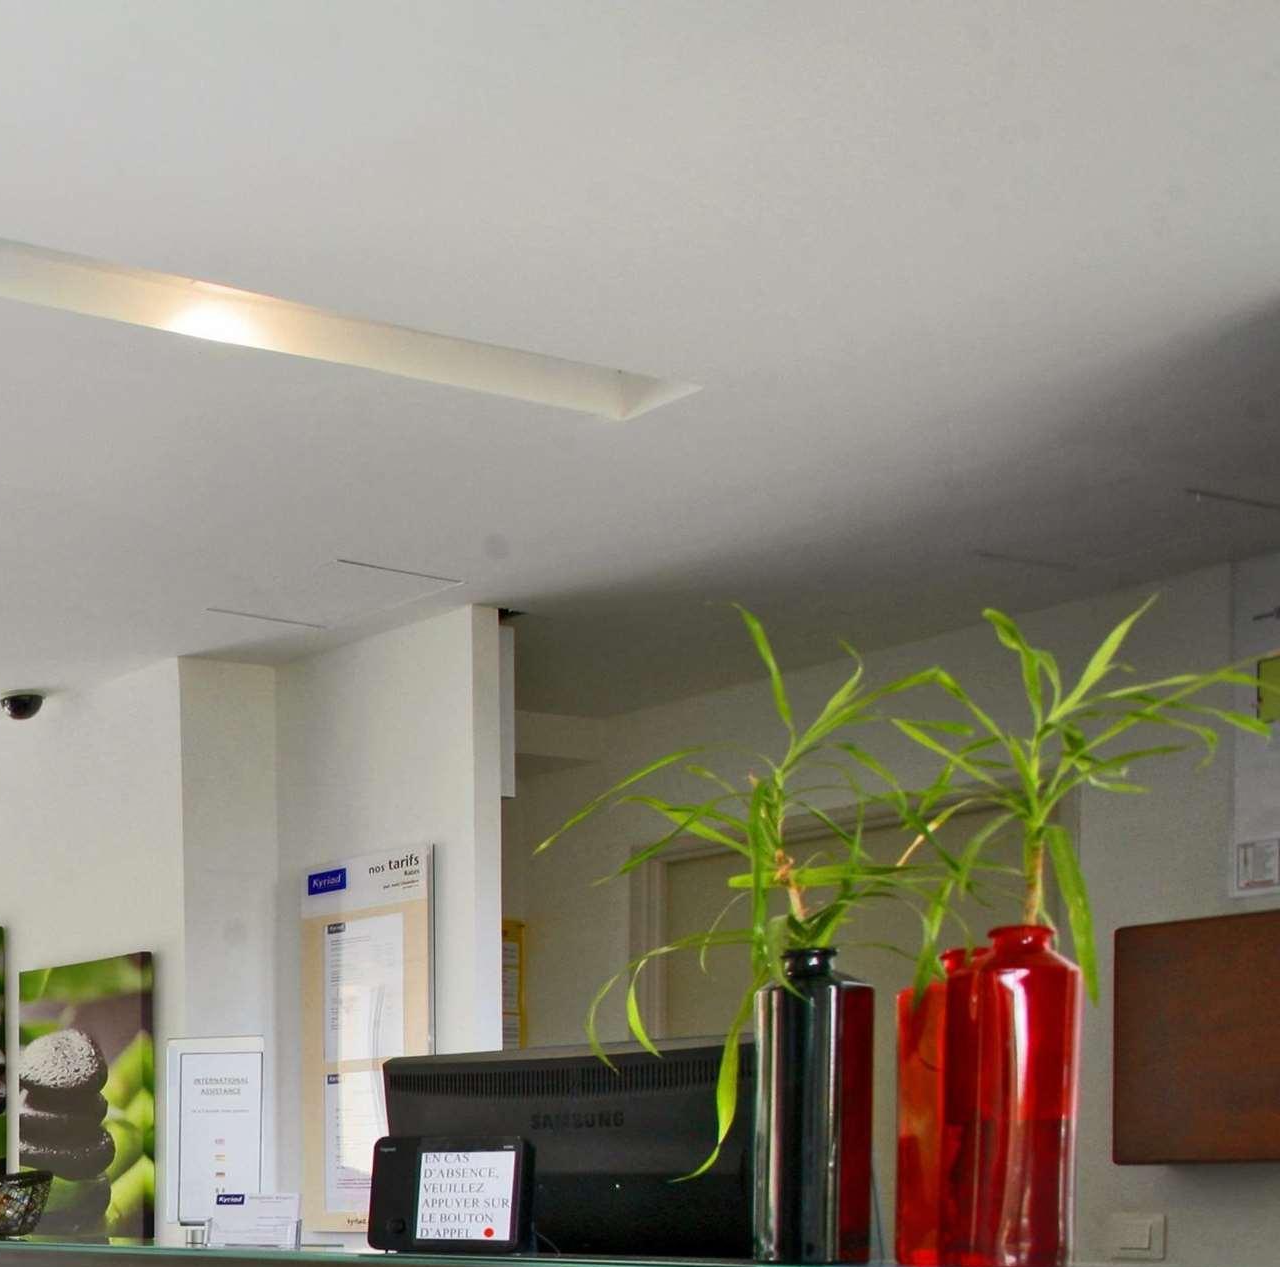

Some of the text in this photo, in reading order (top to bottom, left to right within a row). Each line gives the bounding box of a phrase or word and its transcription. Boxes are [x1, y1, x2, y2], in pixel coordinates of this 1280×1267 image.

[369, 853, 419, 874] nos tarifs
[312, 874, 341, 889] Kyriad
[425, 1152, 470, 1164] EN CAS
[424, 1168, 499, 1179] D'ABSENCE,
[424, 1182, 485, 1193] VEUILLEZ
[422, 1197, 511, 1209] APPUYER SUR
[421, 1213, 494, 1224] LE BOUTON
[420, 1228, 473, 1238] D'APPEL
